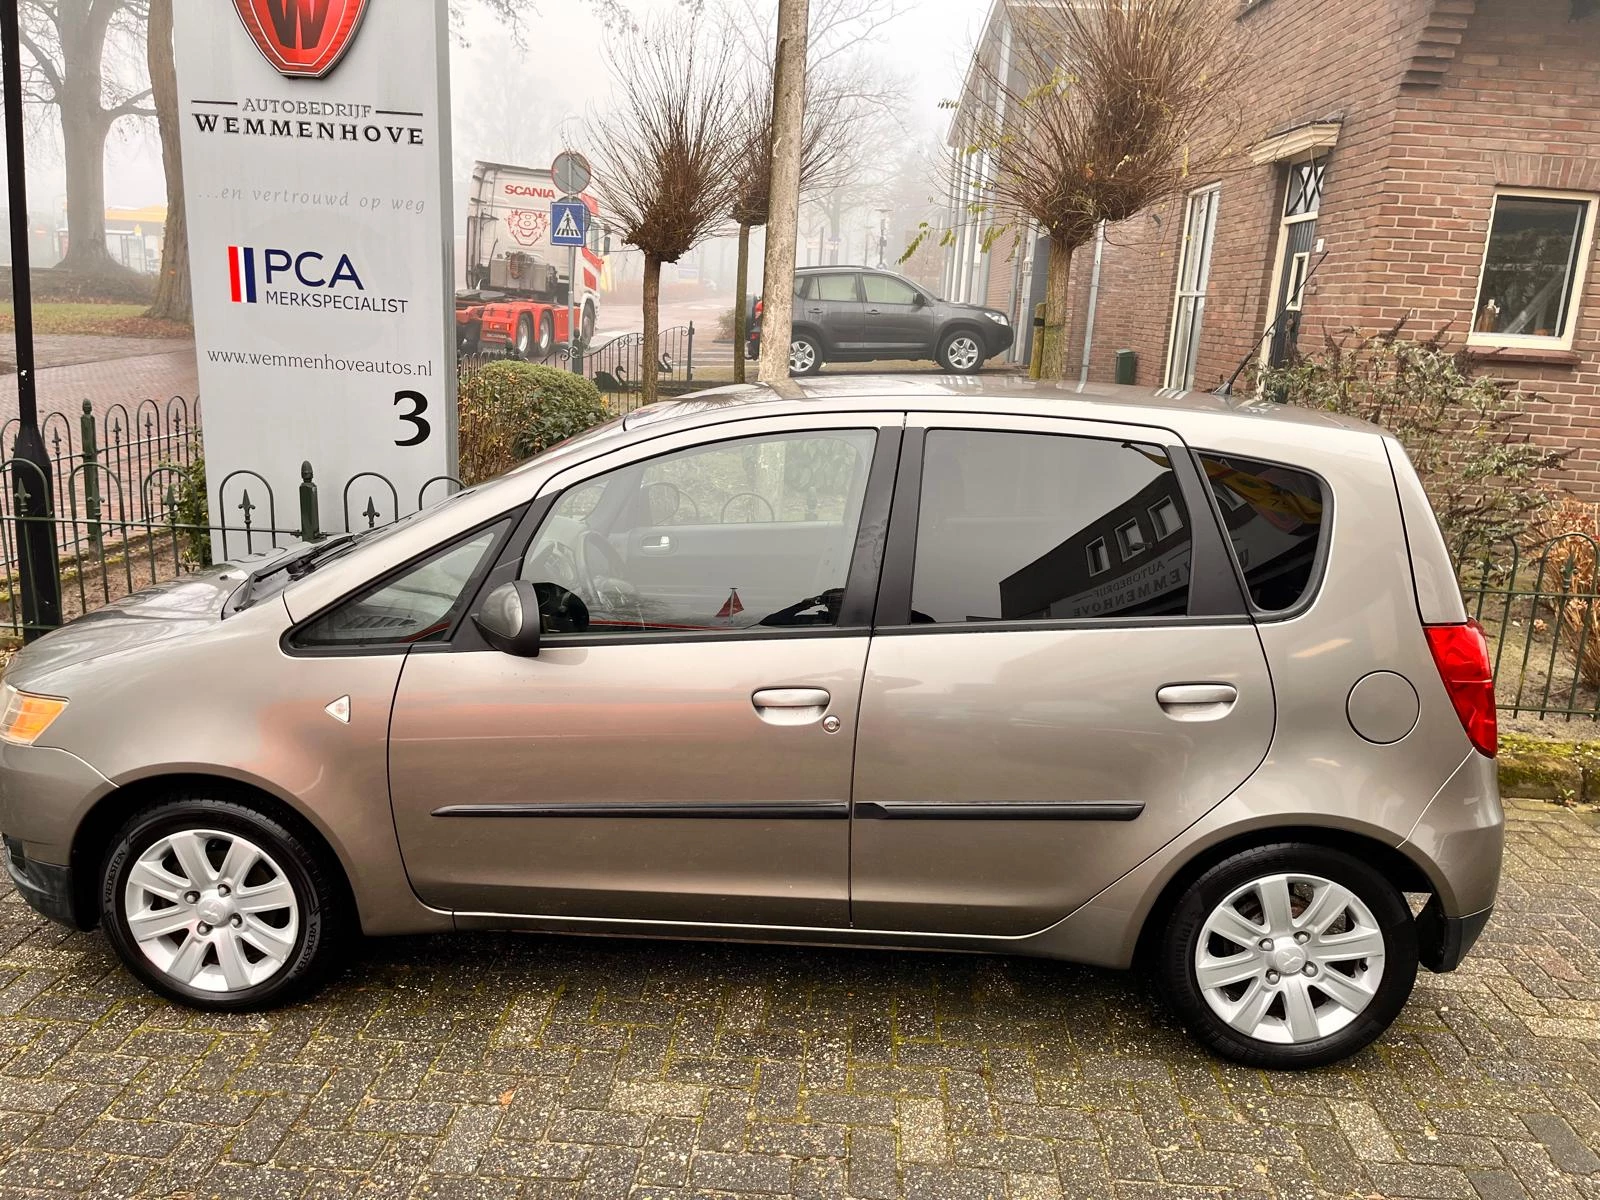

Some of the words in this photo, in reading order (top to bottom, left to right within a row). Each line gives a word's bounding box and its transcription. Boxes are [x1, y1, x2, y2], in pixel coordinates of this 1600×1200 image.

[242, 98, 372, 118] AUTOBEDRIJF
[191, 112, 424, 145] WEMMENHOVE
[253, 188, 349, 207] vertrouwd
[359, 197, 380, 210] op
[391, 199, 425, 214] weg
[504, 184, 555, 199] SCANIA
[264, 248, 365, 291] PCA
[266, 289, 409, 314] MERKSPECIALIST
[207, 350, 432, 377] www.wemmenhoveautos.nl
[393, 390, 431, 447] 3
